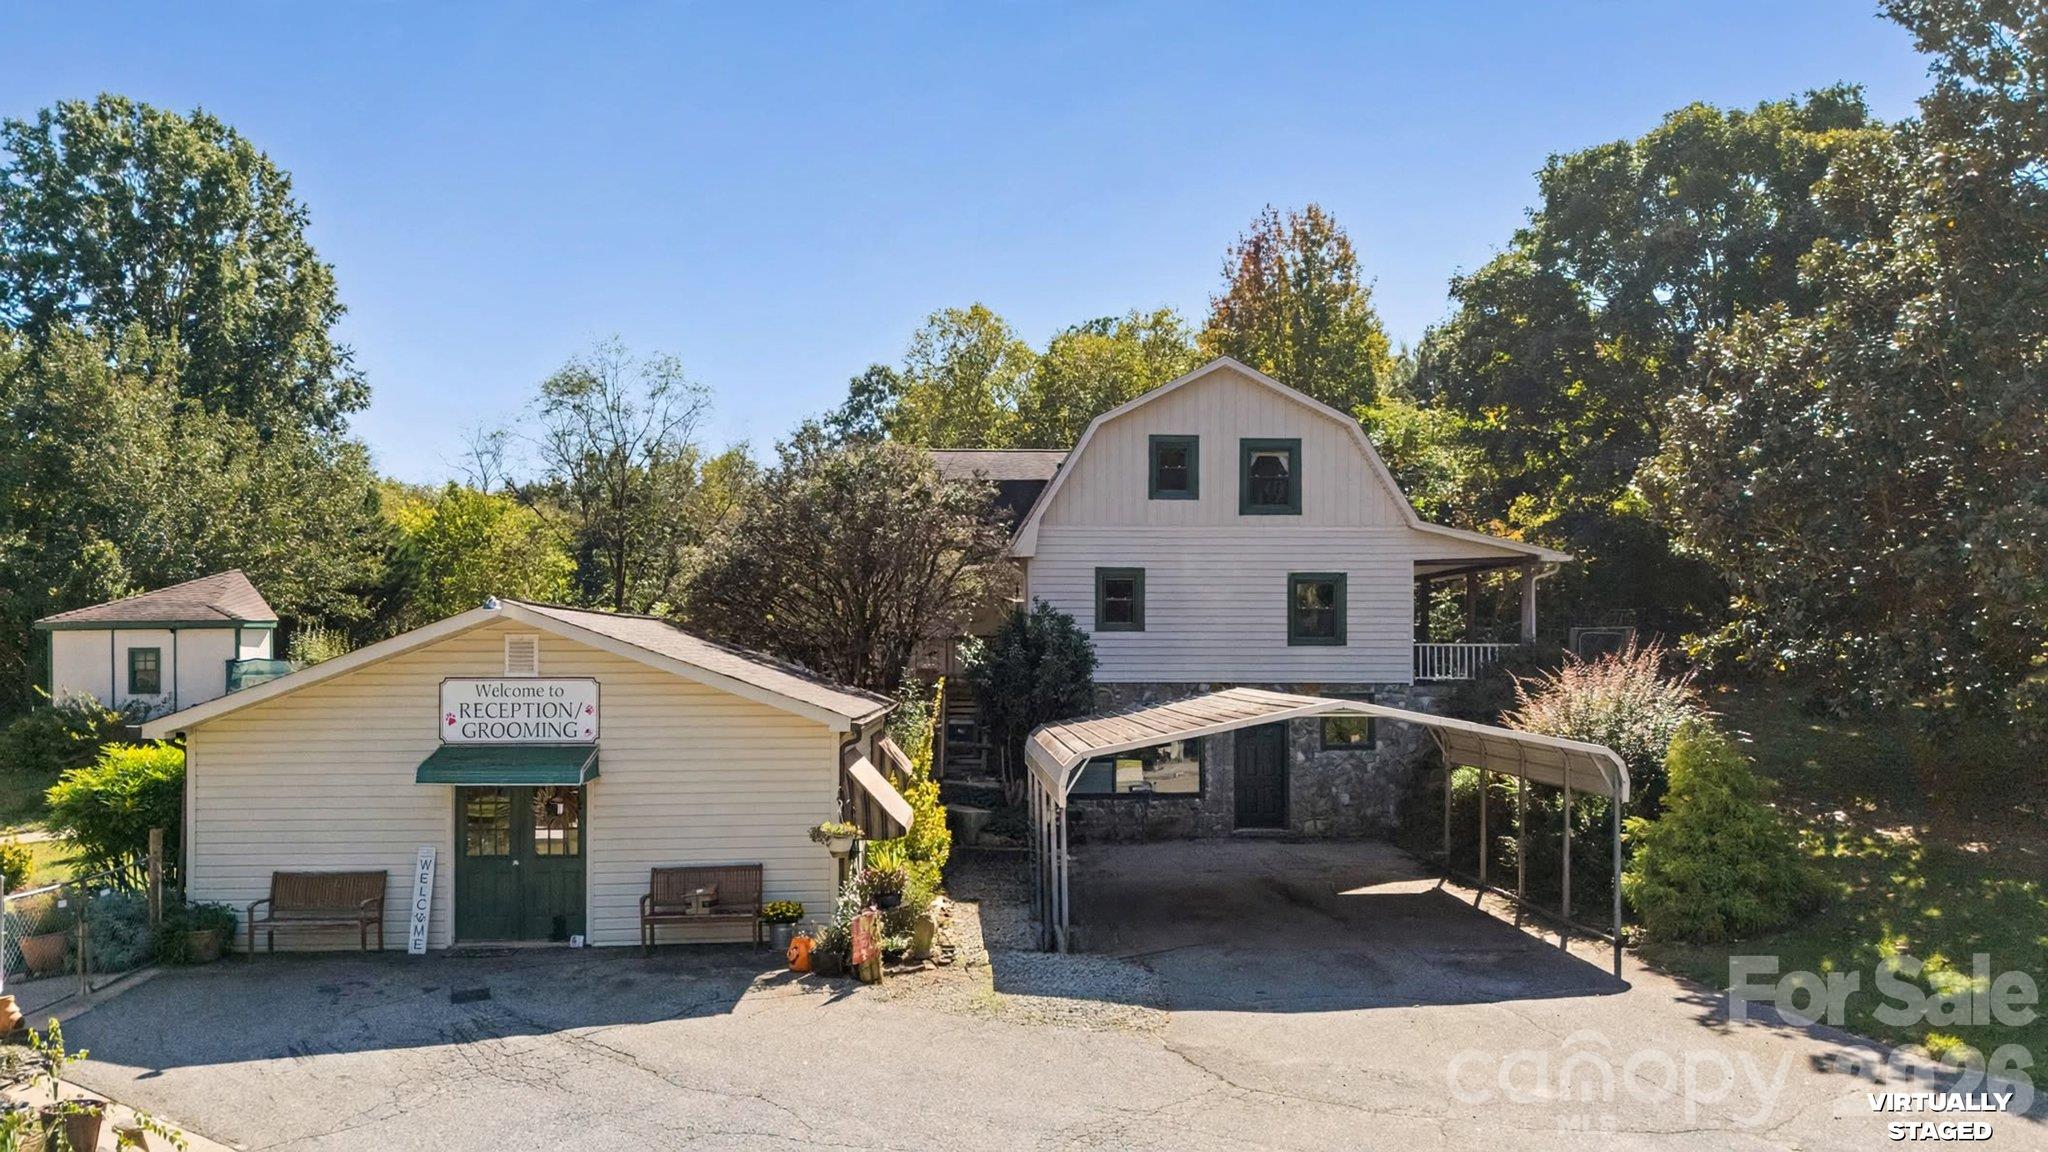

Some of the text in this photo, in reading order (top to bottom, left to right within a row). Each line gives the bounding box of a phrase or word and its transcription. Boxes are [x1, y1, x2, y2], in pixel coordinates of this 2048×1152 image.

[475, 683, 565, 698] Welcome to
[459, 702, 583, 720] RECEPTION/
[461, 722, 578, 739] GROOMING
